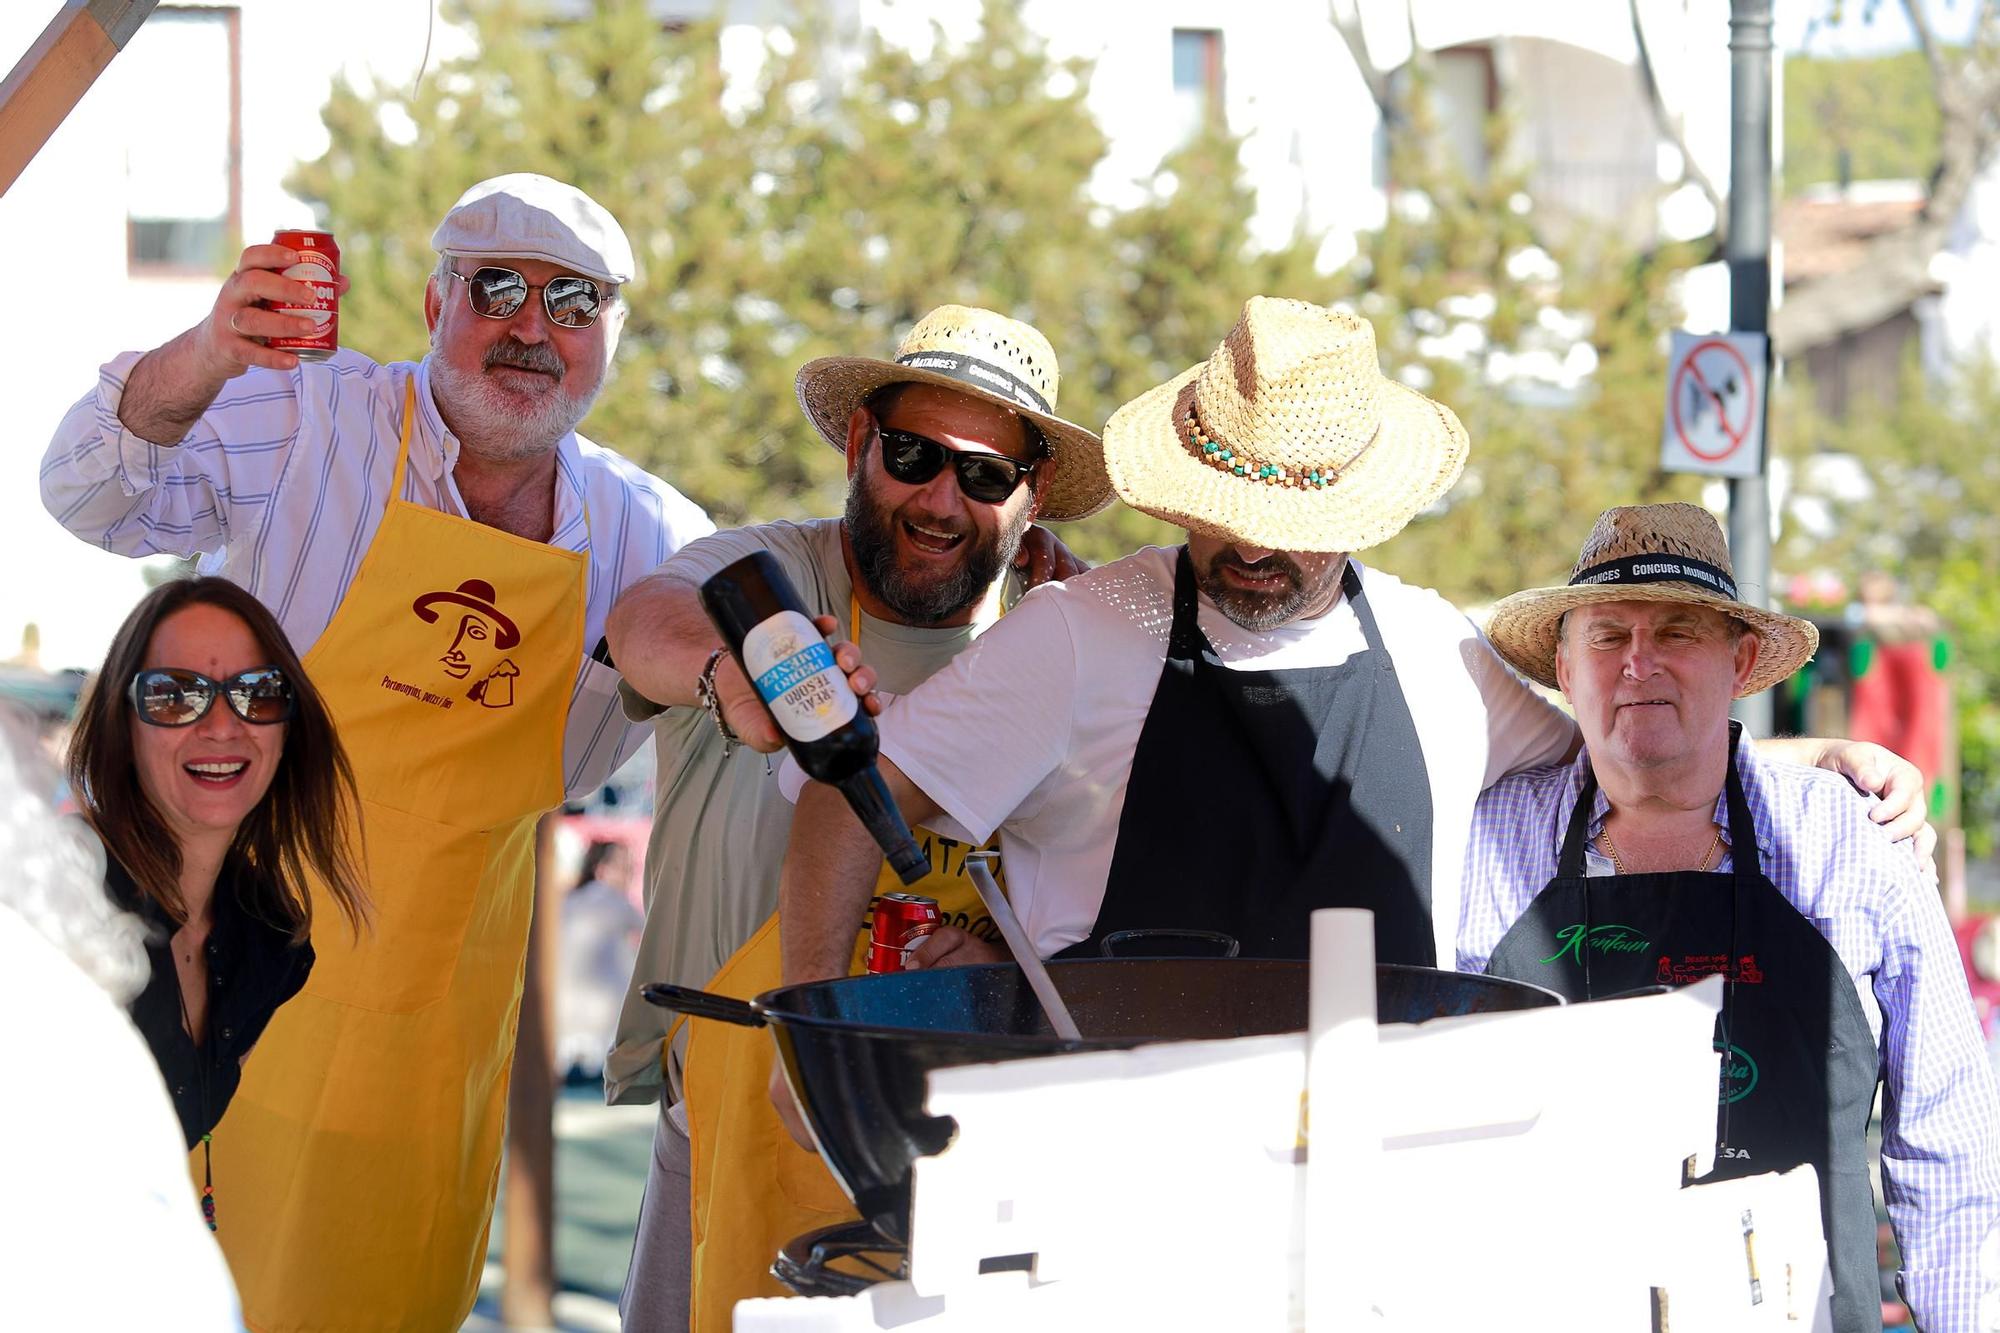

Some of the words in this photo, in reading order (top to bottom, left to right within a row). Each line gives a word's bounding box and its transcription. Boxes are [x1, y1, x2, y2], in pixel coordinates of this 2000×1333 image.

[1632, 564, 1681, 576] CONCURS
[1682, 565, 1717, 587] MUNDIAL
[774, 658, 825, 692] PEDRO
[784, 673, 831, 706] TESORO
[800, 688, 832, 712] REAL
[1719, 1147, 1751, 1159] SA
